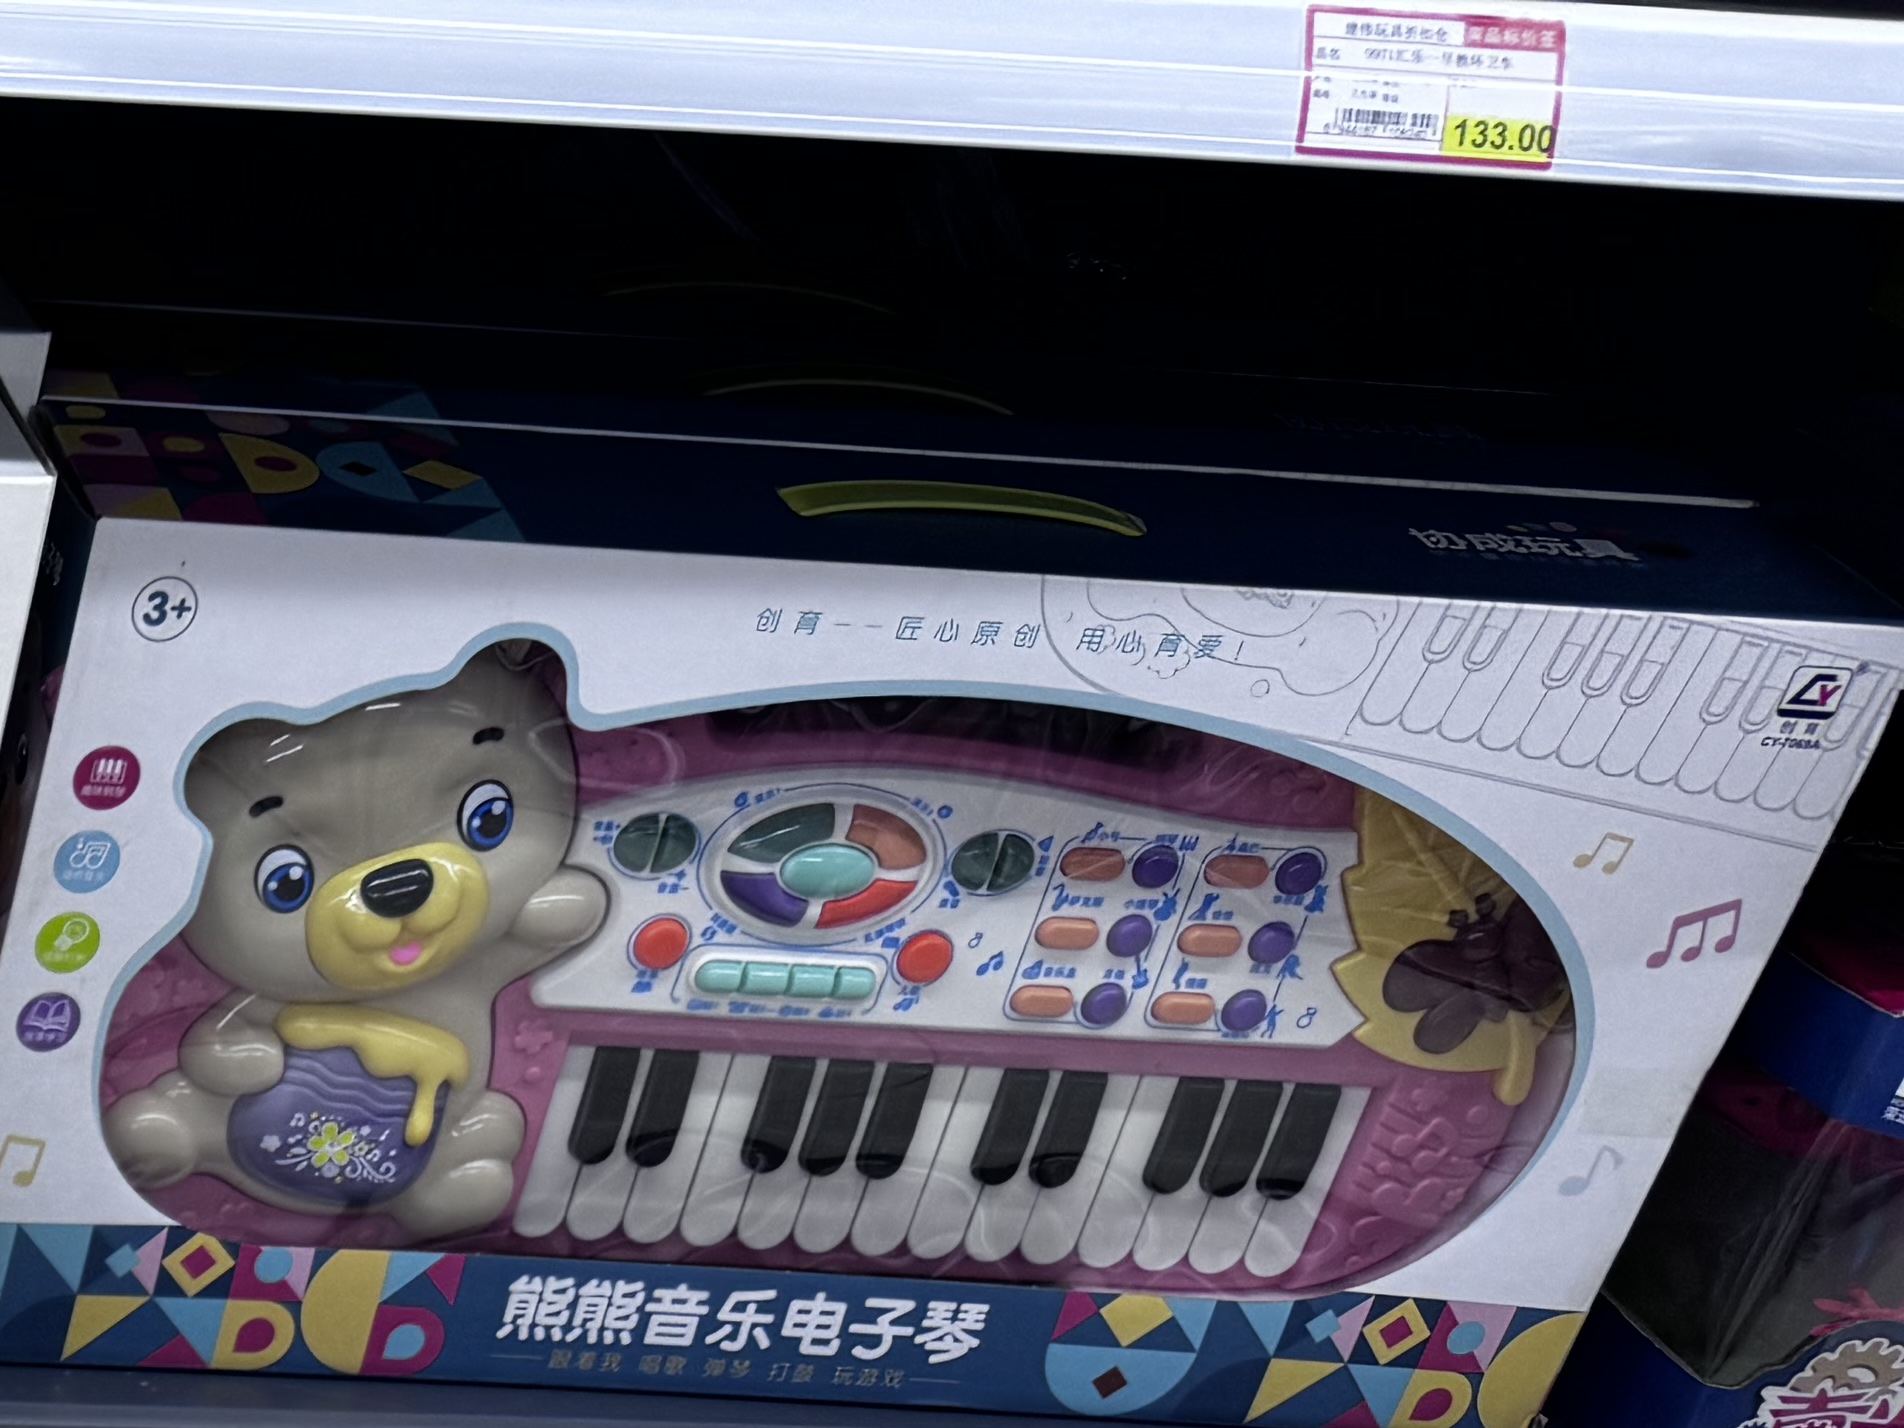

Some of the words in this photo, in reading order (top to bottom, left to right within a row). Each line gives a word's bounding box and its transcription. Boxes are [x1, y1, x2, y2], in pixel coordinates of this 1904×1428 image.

[1454, 118, 1557, 153] 133.00
[142, 590, 193, 628] 3+
[495, 1275, 991, 1364] 熊熊音乐电子琴
